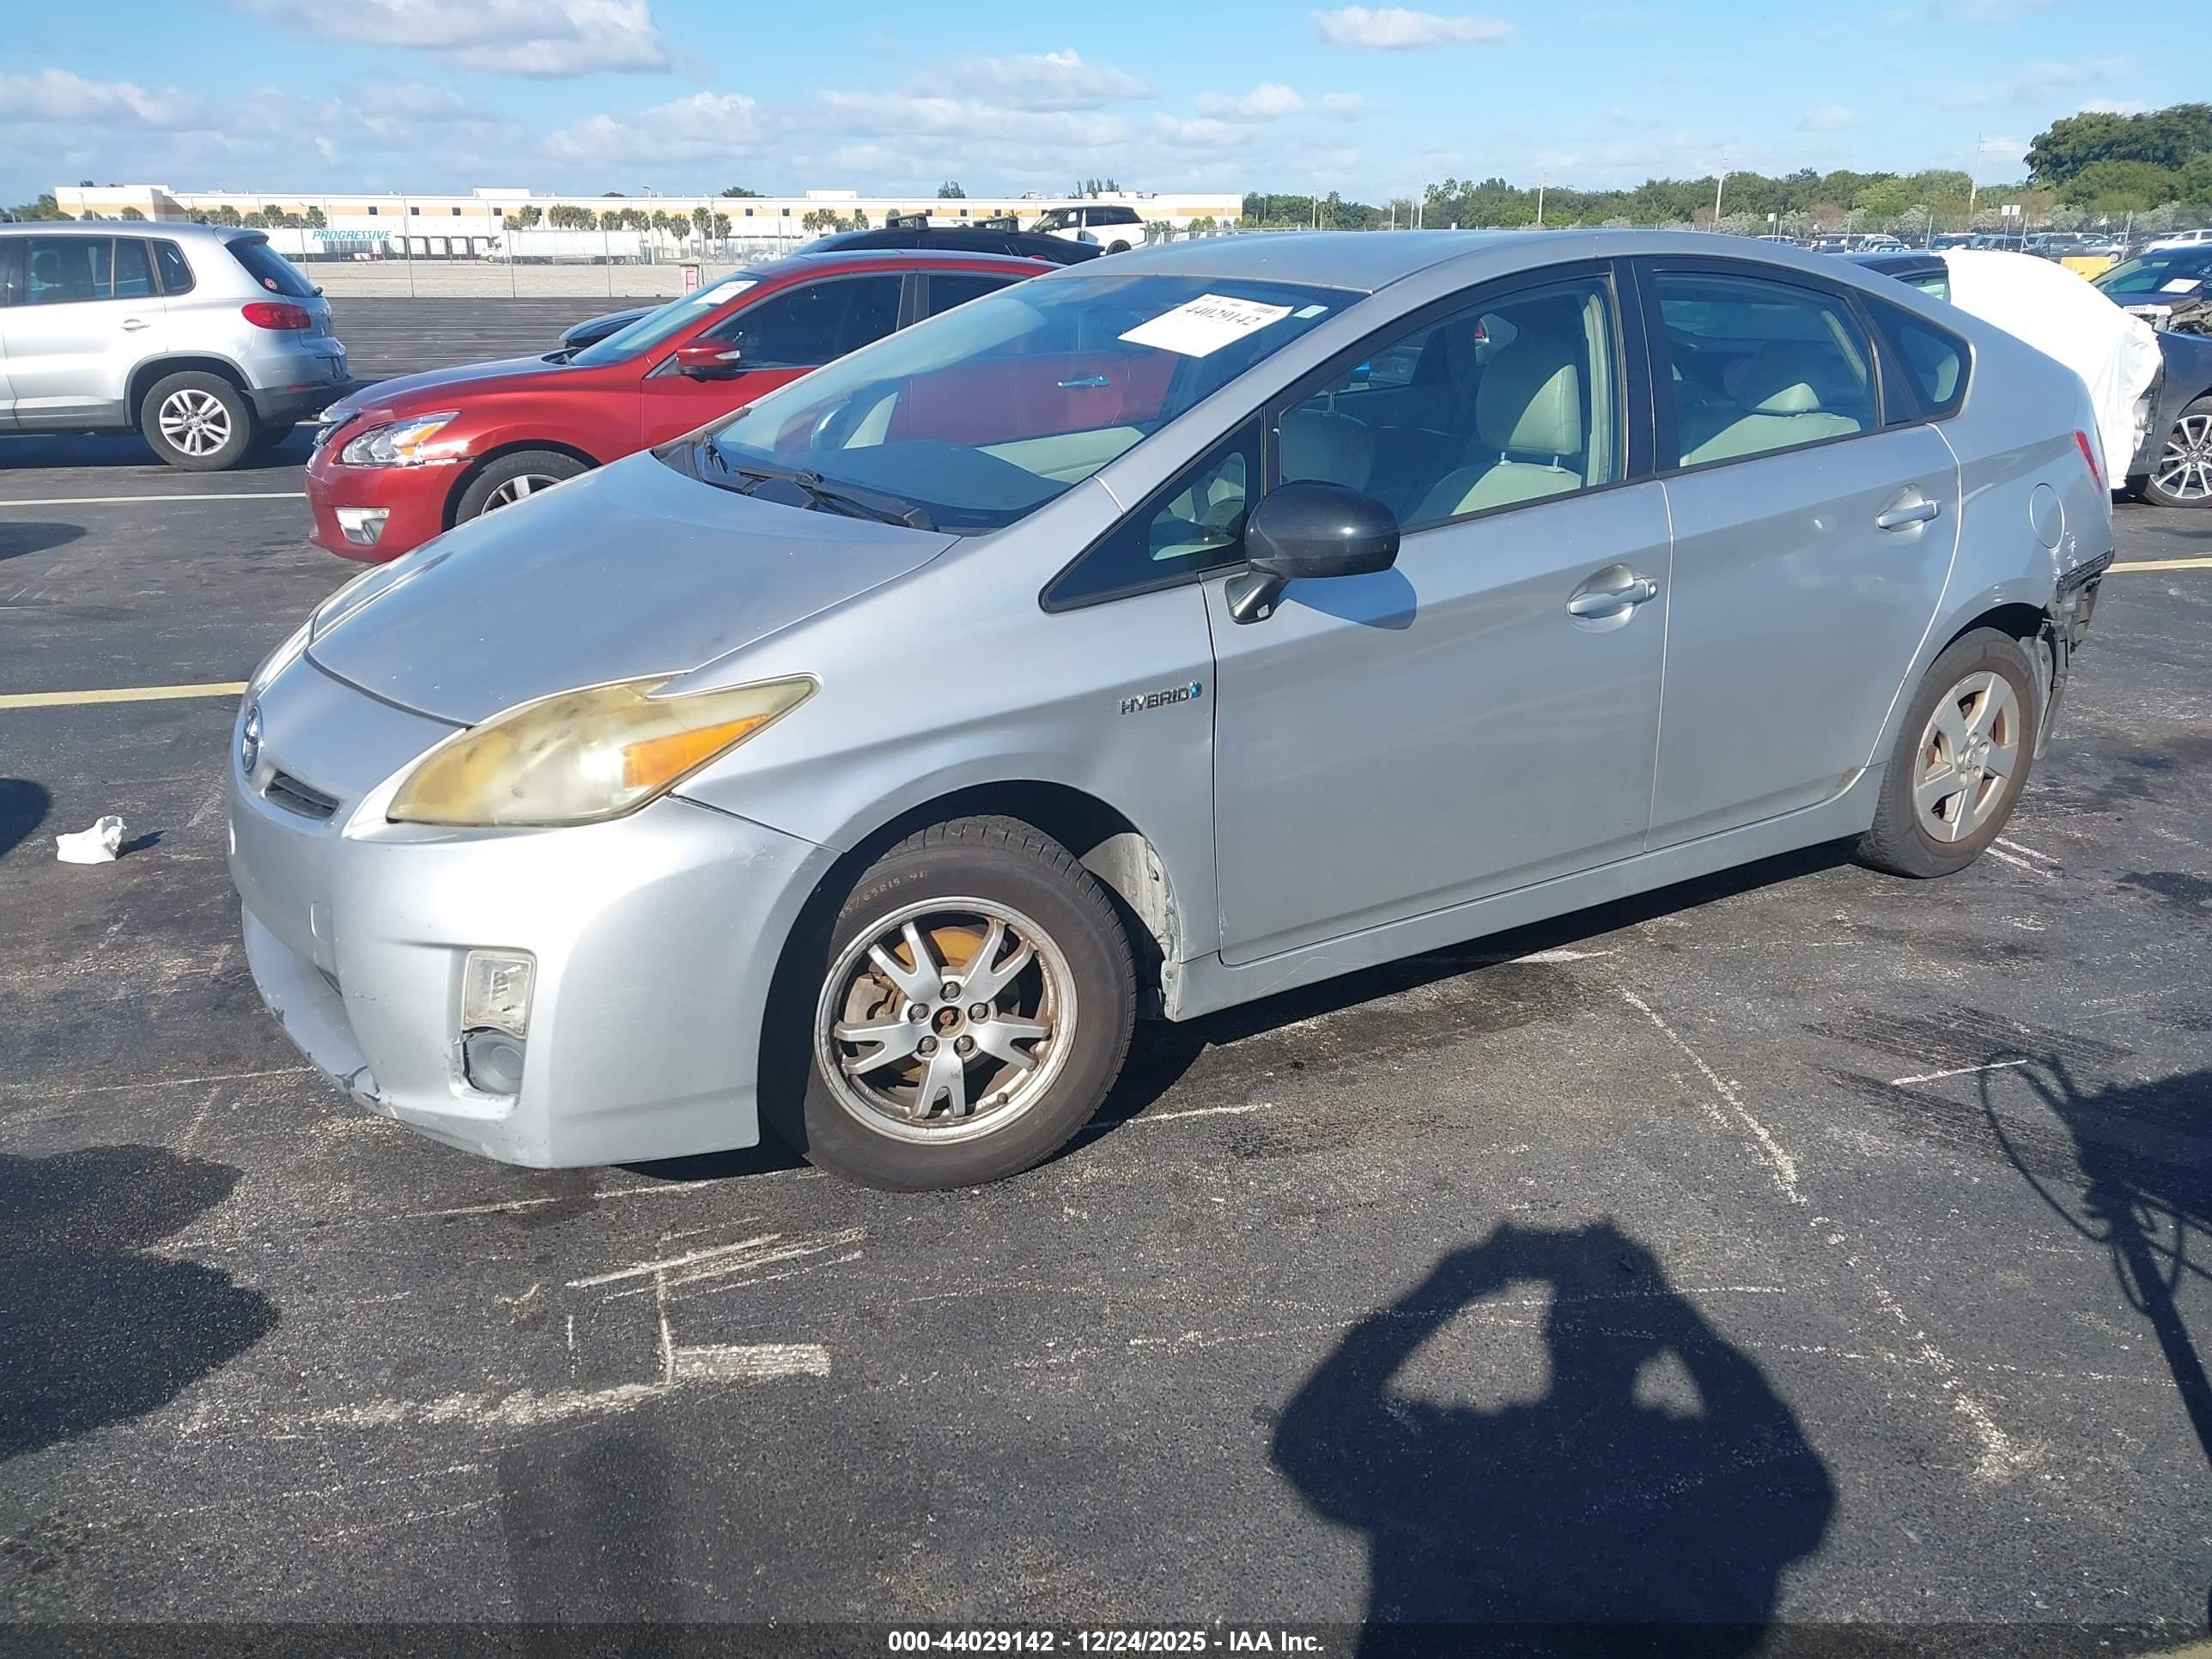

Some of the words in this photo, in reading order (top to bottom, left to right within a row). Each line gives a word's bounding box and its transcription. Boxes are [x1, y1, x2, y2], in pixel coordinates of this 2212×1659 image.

[312, 230, 392, 240] PROGRESSIVE
[1185, 305, 1261, 325] 44029142
[1120, 686, 1190, 715] HYBRID
